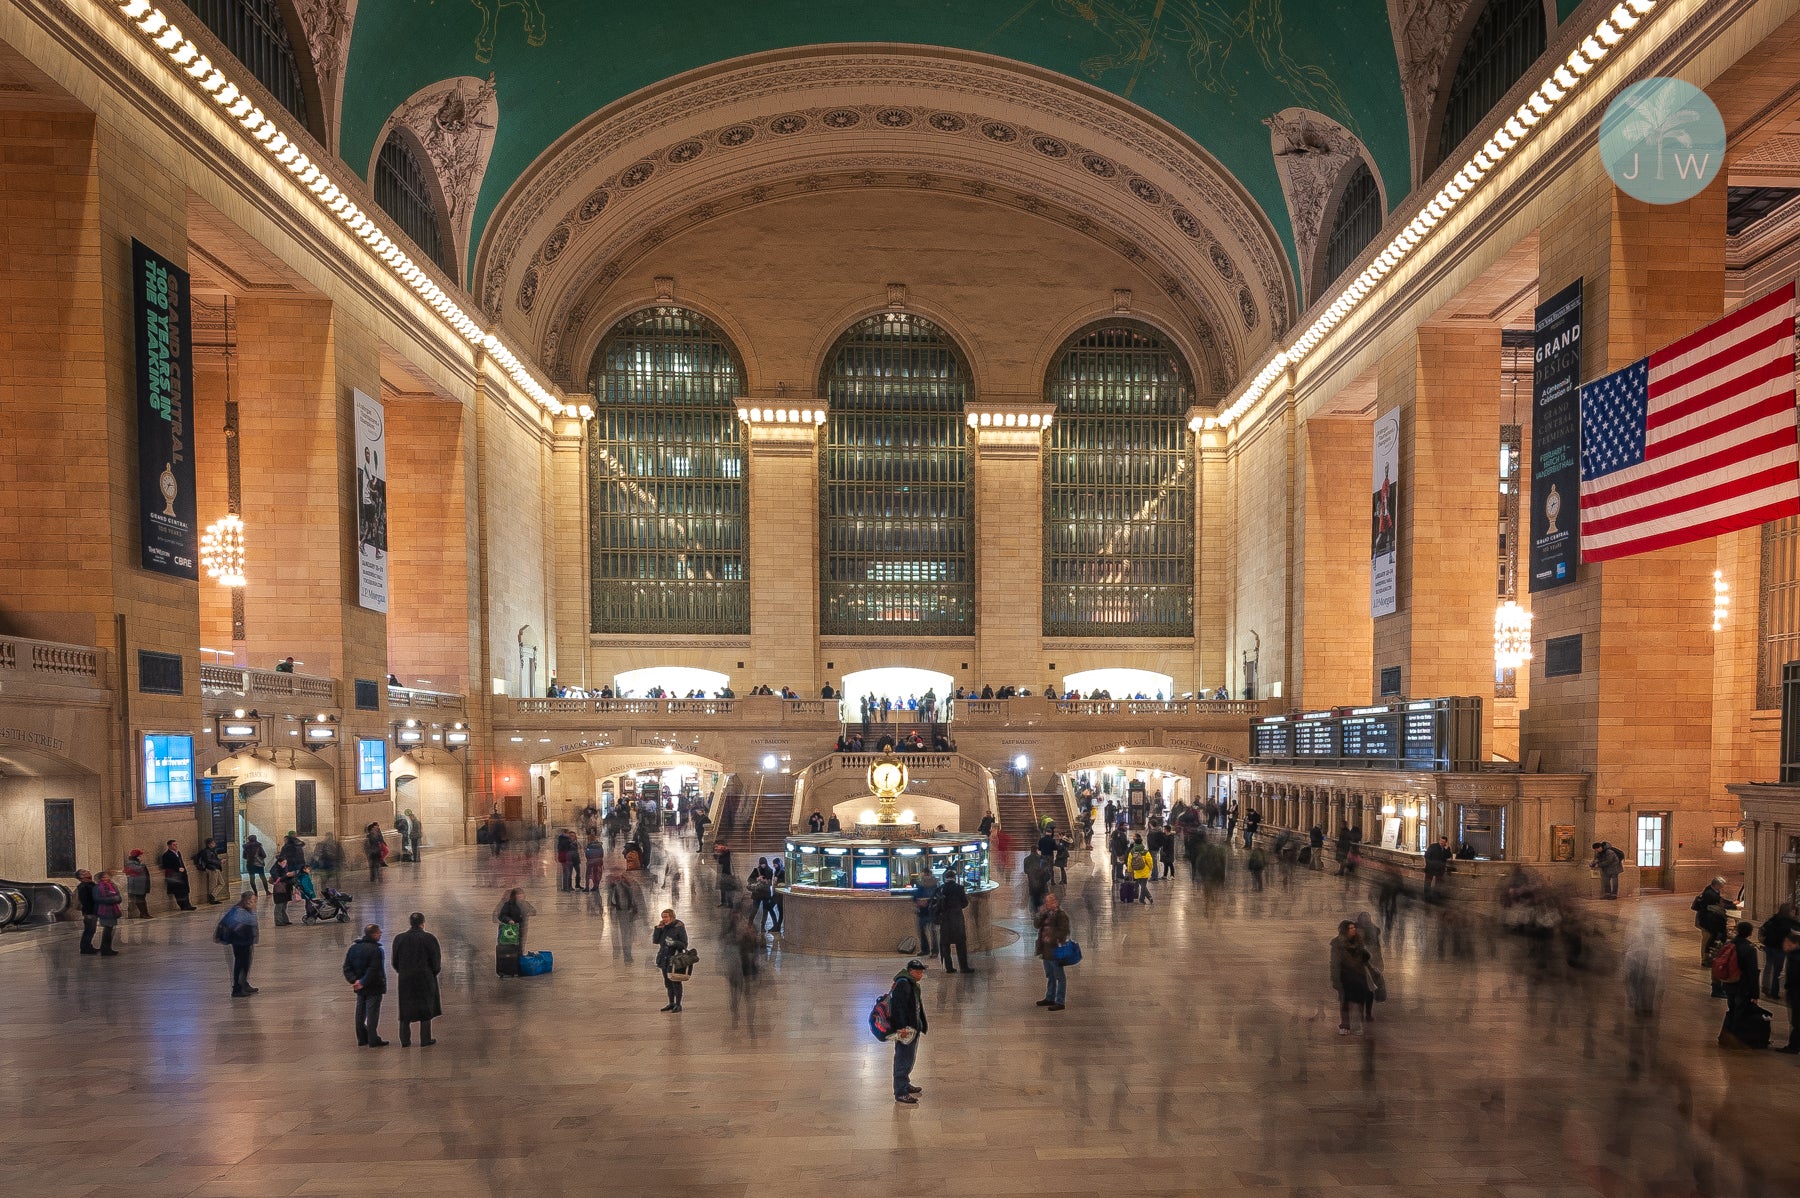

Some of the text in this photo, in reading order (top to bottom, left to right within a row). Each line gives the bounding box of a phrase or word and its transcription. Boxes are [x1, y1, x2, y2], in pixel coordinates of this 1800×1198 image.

[146, 260, 160, 410] THE MAKING
[156, 266, 172, 422] 100 YEARS IN
[1536, 324, 1580, 363] GRAND
[168, 274, 184, 464] GRAND CENTRAL
[1536, 347, 1580, 384] DESIGN
[150, 512, 188, 528] GRAND CENTRAL
[1550, 530, 1569, 541] CENTRAL
[174, 556, 192, 568] CBRE
[28, 731, 64, 750] STREET
[560, 742, 588, 752] TRACKS
[1091, 740, 1130, 752] LEXINGTON
